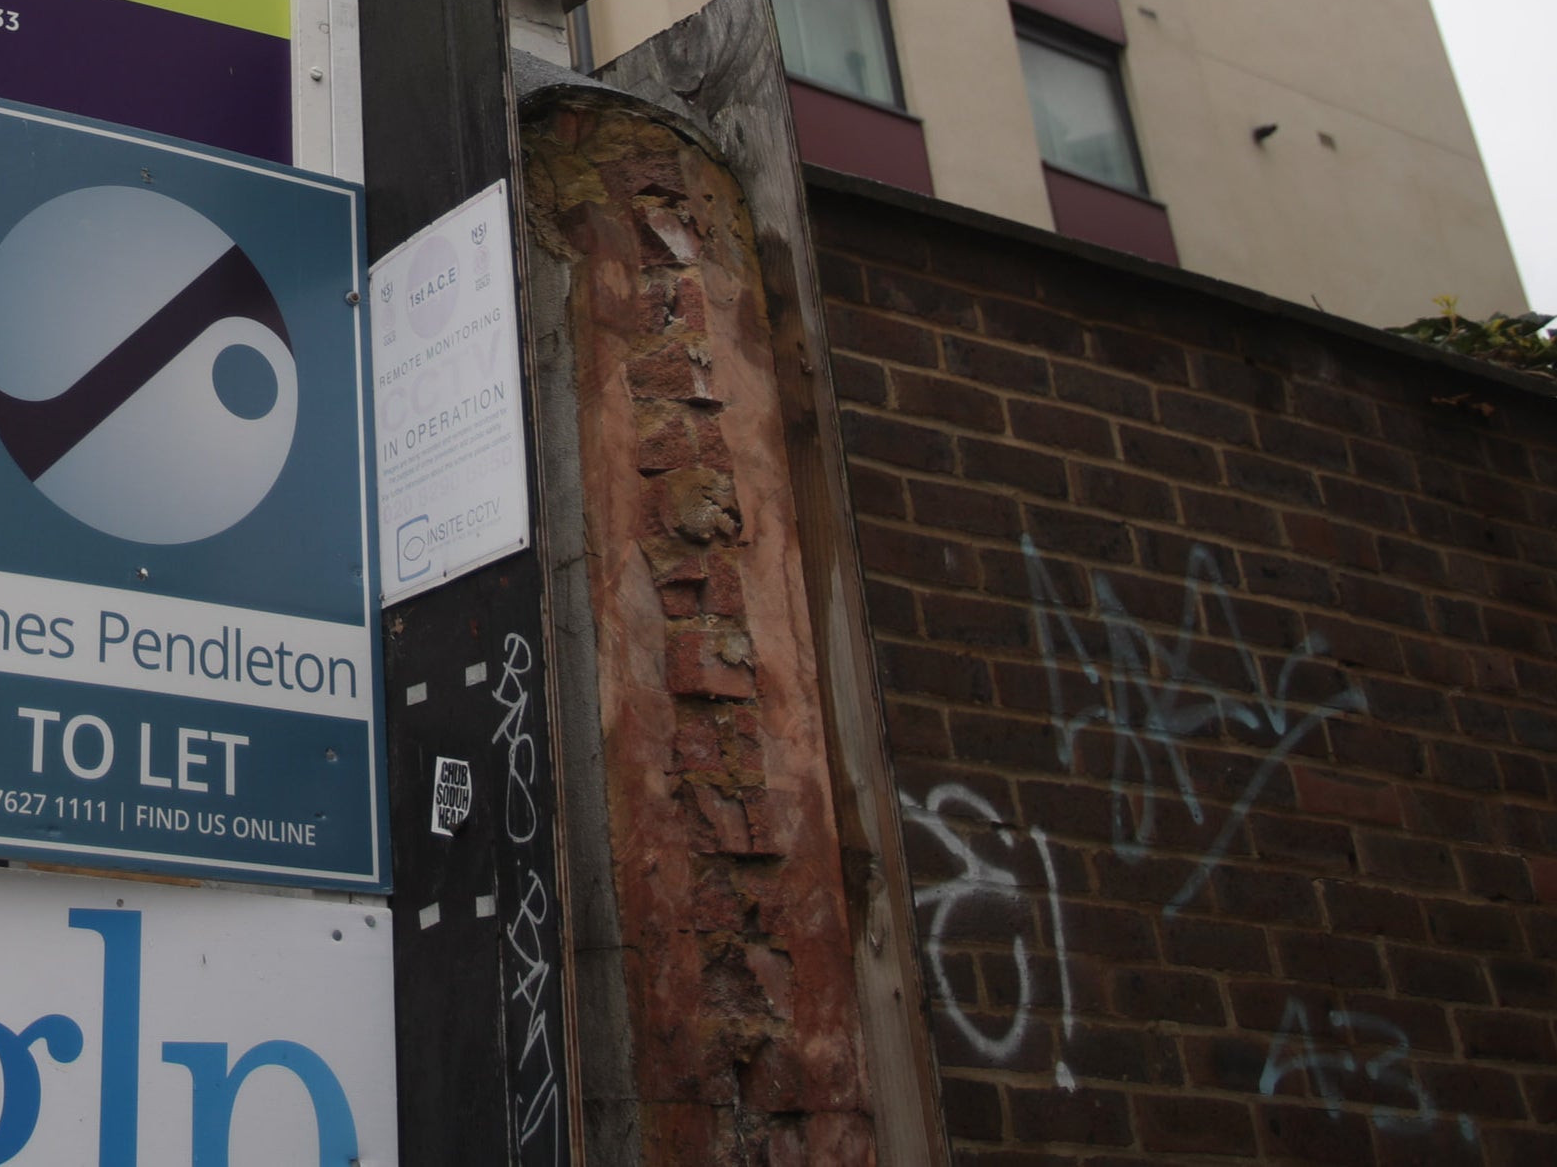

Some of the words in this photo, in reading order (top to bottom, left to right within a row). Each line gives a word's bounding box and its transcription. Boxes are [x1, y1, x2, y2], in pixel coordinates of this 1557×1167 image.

[409, 285, 424, 309] 1st
[427, 264, 456, 299] A.C.E
[379, 352, 421, 389] REMOTE
[426, 304, 501, 362] MONITORING
[383, 436, 398, 463] IN
[405, 378, 505, 450] OPERATION
[426, 513, 463, 547] INSITE
[466, 495, 501, 528] CCTV
[97, 610, 359, 699] Pendleton
[18, 706, 115, 782] TO
[138, 722, 250, 797] LET
[441, 761, 468, 786] CHUB
[54, 794, 108, 825] 1111
[135, 805, 192, 836] FIND
[197, 811, 227, 837] US
[232, 814, 317, 848] ONLINE
